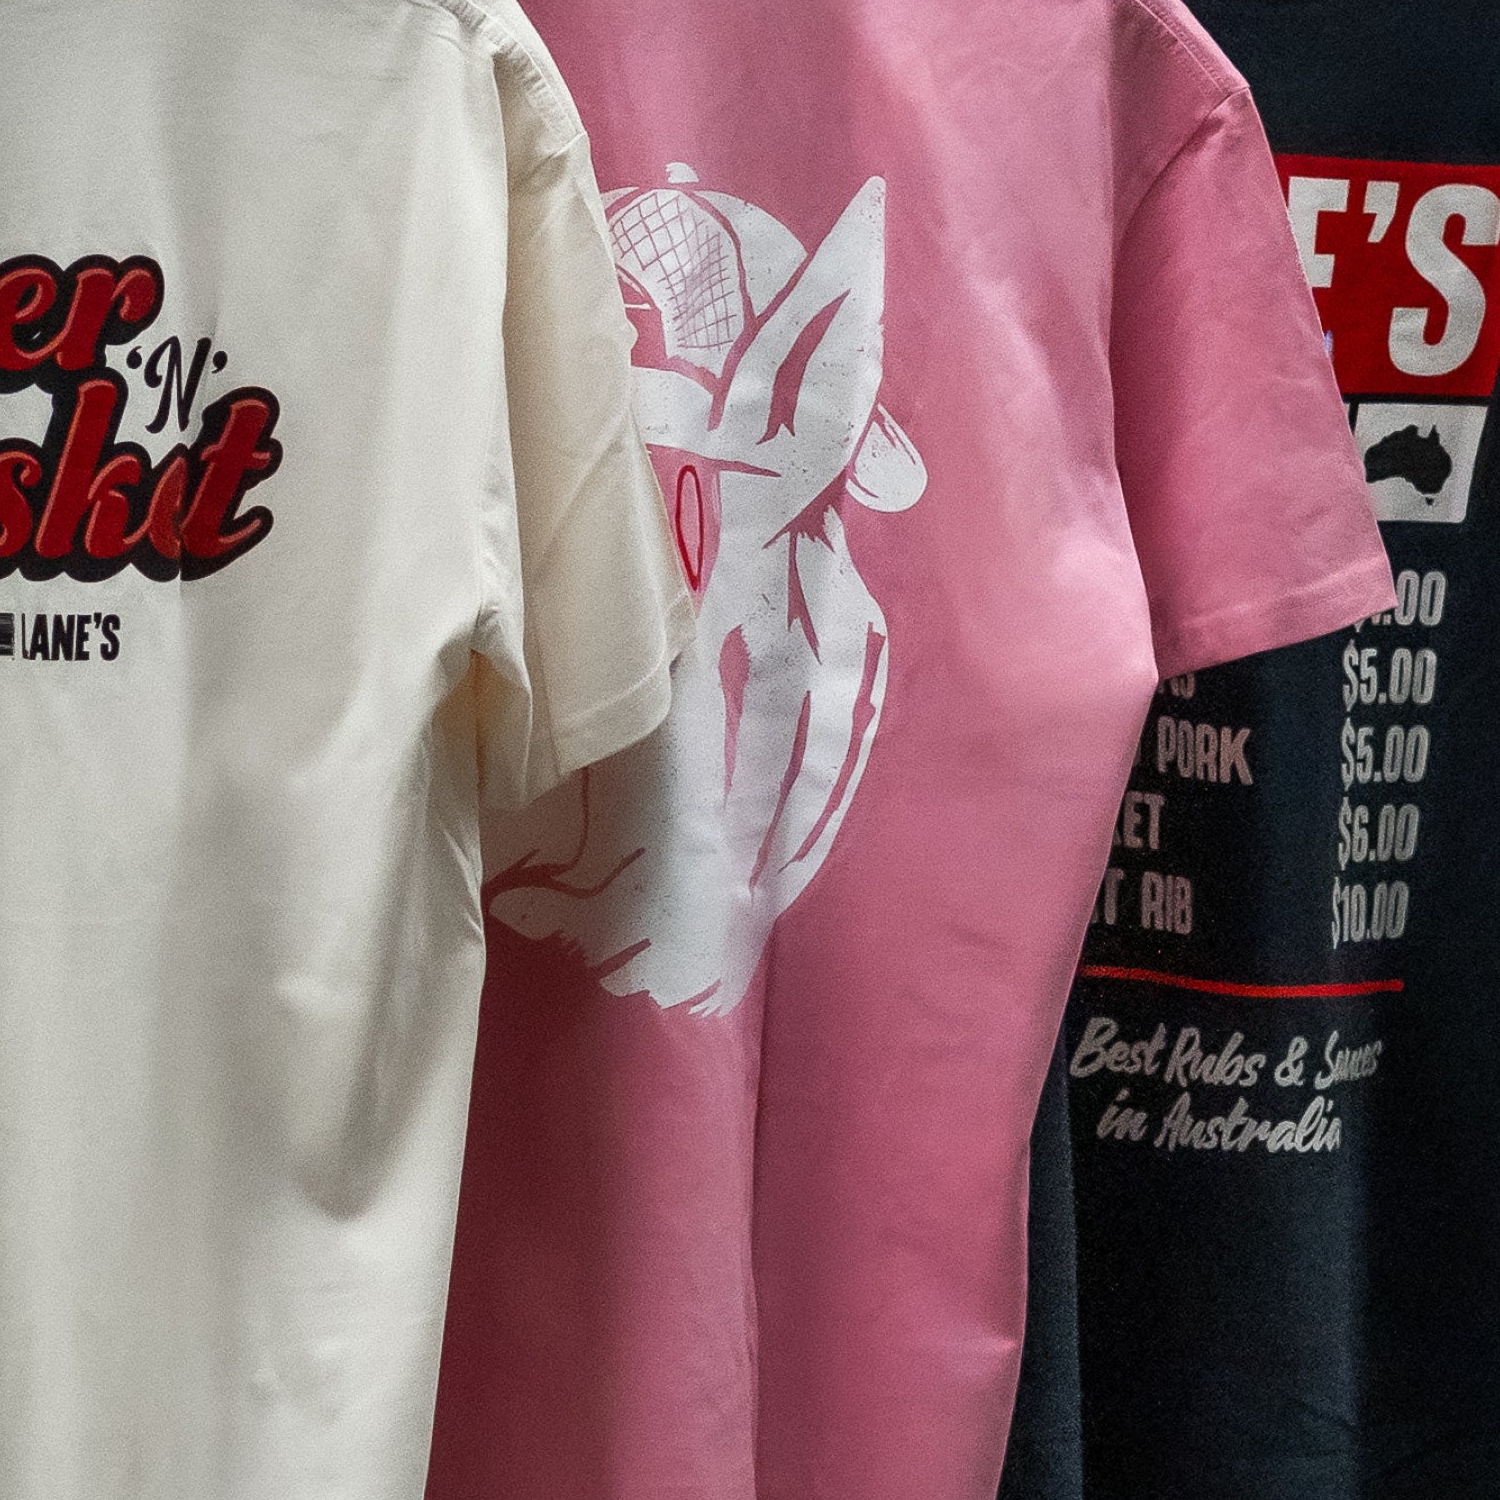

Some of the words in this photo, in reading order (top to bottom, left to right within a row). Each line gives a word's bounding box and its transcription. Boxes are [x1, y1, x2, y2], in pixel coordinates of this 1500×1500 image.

[21, 611, 121, 661] LANE'S
[1342, 639, 1438, 713] $5.00
[1156, 715, 1254, 786] PORK
[1340, 716, 1431, 792] $5.00
[1337, 796, 1420, 871] $6.00
[1140, 871, 1194, 936] RIB
[1331, 876, 1409, 950] $10.00
[1069, 1016, 1167, 1078] Best
[1163, 1026, 1267, 1088] Rubs
[1273, 1035, 1309, 1088] &
[1096, 1088, 1148, 1142] in
